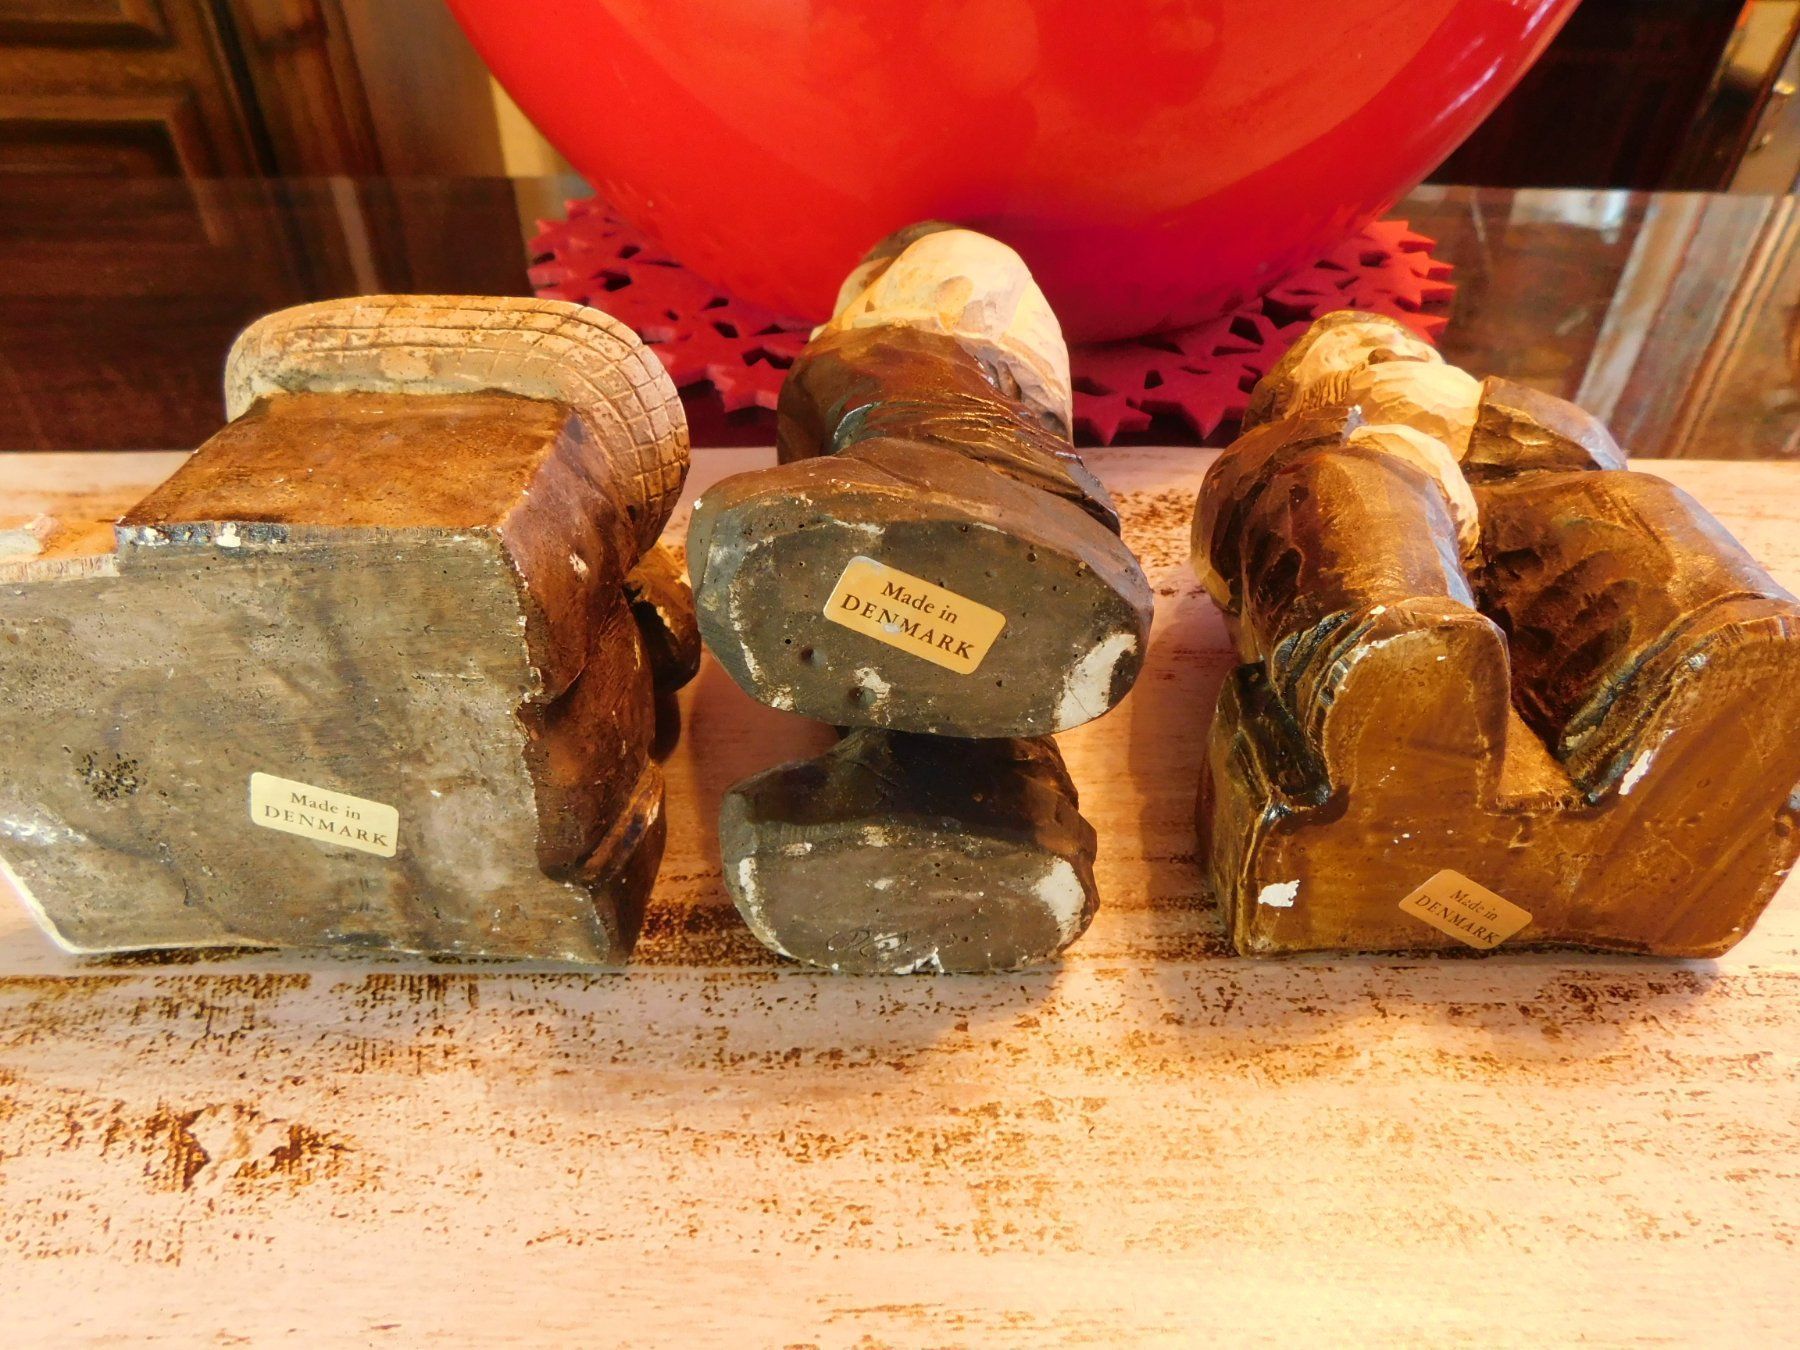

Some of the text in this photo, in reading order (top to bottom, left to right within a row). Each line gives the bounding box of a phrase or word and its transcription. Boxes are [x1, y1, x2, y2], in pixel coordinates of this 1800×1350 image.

[880, 581, 958, 624] Made in
[840, 593, 975, 659] DENMARK
[264, 805, 388, 847] DENMARK
[291, 792, 361, 820] Made in
[1415, 895, 1500, 944] DENMARK
[1450, 889, 1498, 921] Made in
